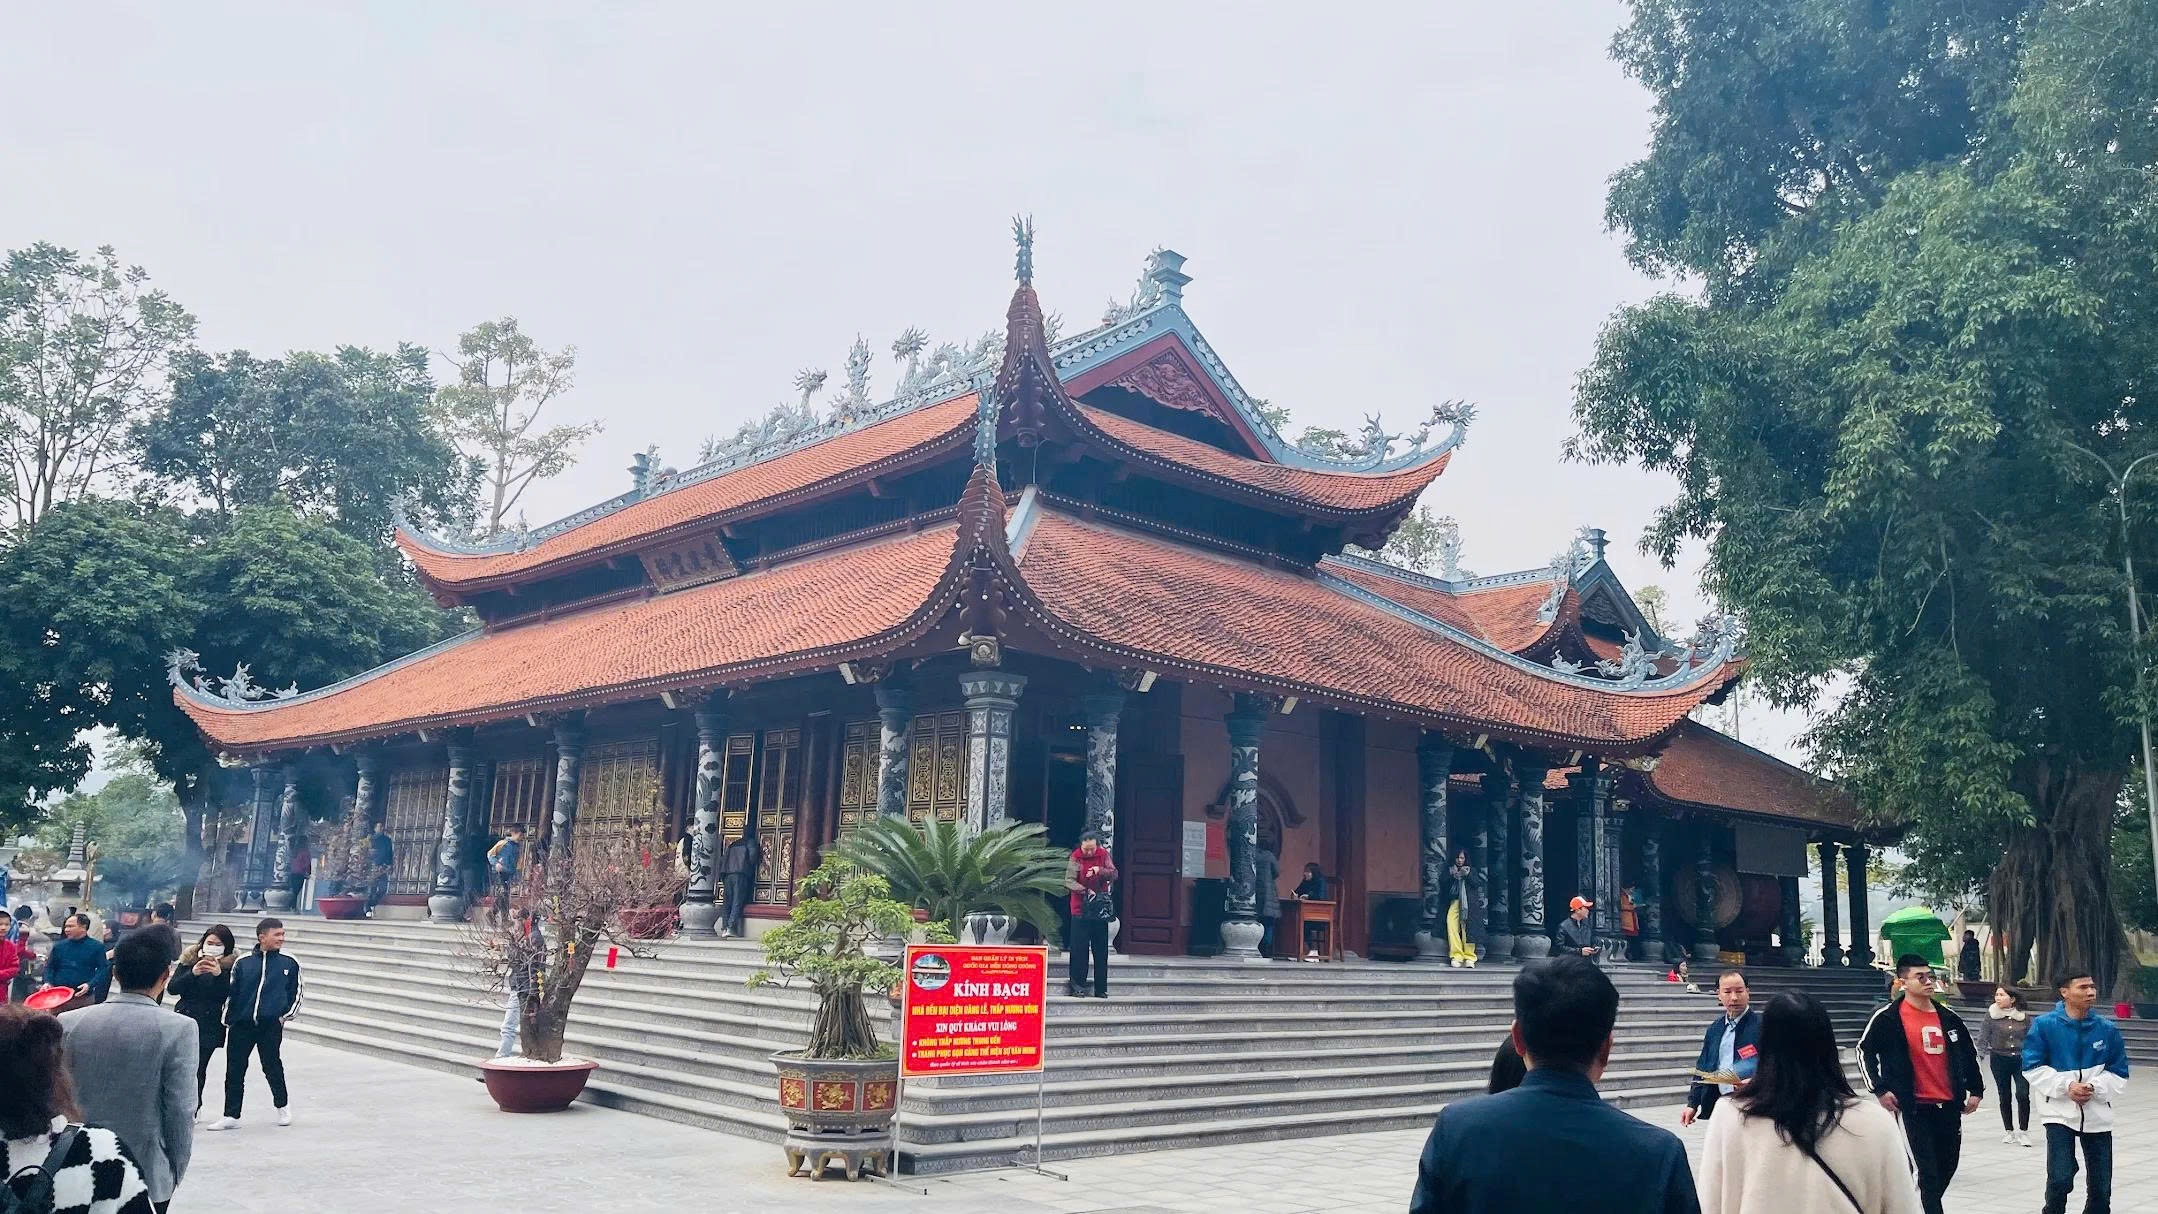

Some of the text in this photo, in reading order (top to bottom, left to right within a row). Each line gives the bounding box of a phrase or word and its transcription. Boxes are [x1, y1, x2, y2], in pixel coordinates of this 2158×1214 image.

[953, 979, 1030, 1000] KÍNH BẠCH
[935, 1020, 1017, 1034] XIN QUÝ KHÁCH VUI LÒNG
[1922, 1026, 1943, 1054] C
